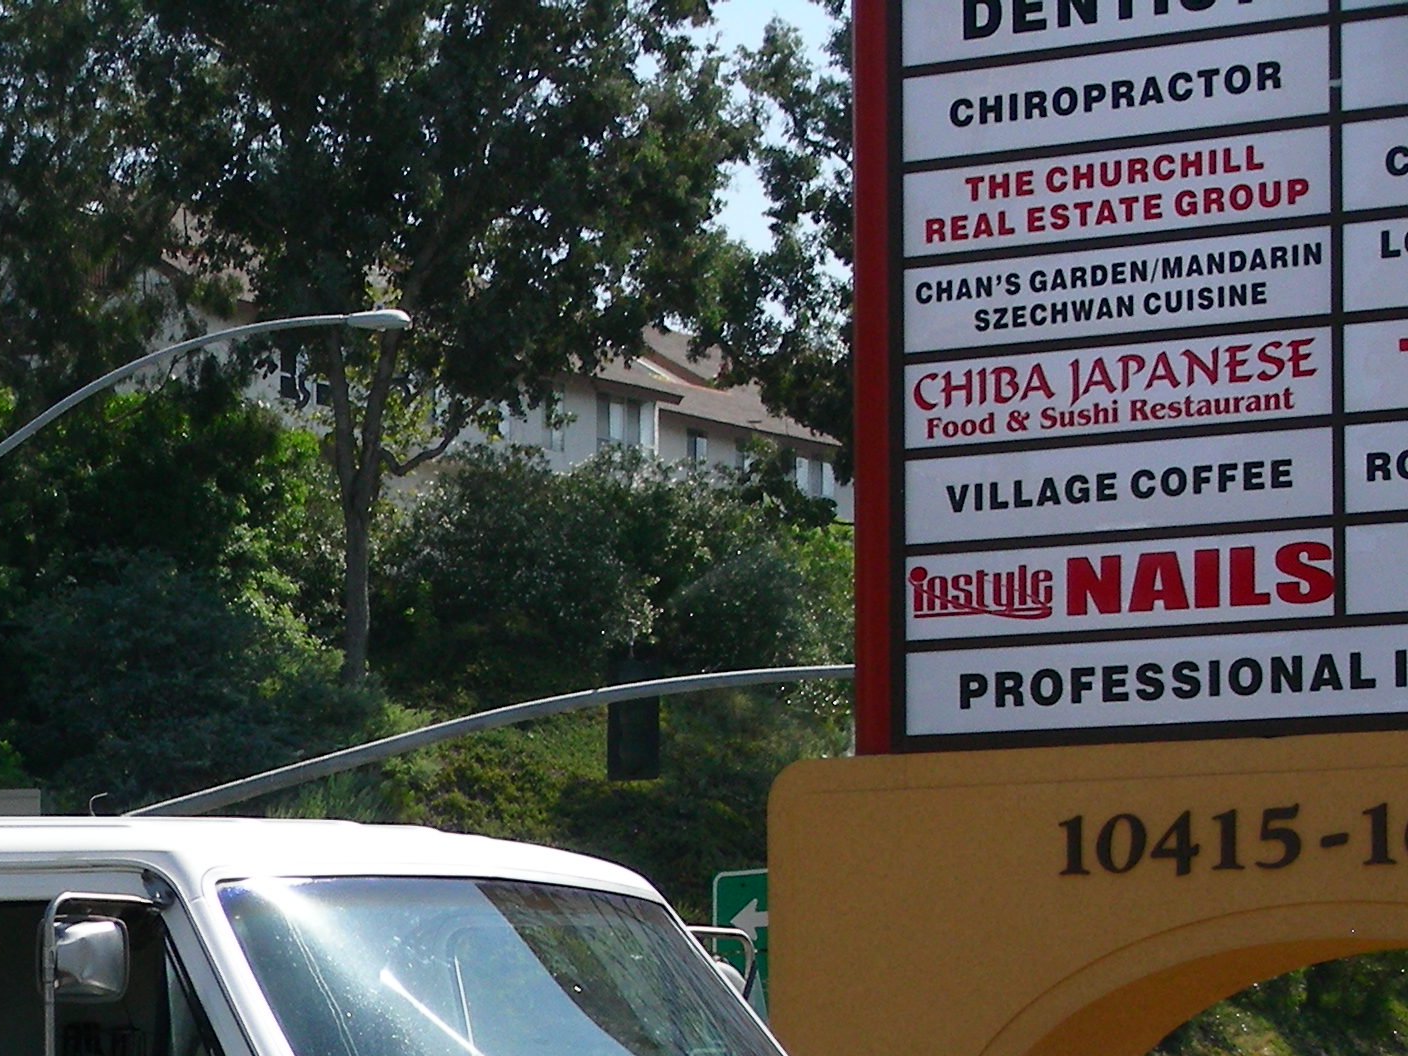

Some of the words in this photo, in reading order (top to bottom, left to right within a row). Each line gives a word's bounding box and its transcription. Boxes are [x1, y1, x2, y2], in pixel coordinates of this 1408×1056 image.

[949, 61, 1282, 128] CHIROPRACTOR
[965, 170, 1034, 202] THE
[1046, 145, 1264, 193] CHURCHILL
[925, 209, 1015, 244] REAL
[1027, 193, 1163, 233] ESTATE
[1174, 178, 1309, 217] GROUP
[915, 271, 1021, 304] CHAN'S
[1029, 242, 1323, 293] GARDEN/MANDARIN
[974, 294, 1134, 333] SZECHWAN
[1143, 282, 1268, 315] CUISINE
[913, 364, 1055, 411] CHIBA
[1068, 337, 1318, 405] JAPANESE
[926, 413, 995, 440] Food
[1006, 409, 1029, 432] &
[1040, 399, 1119, 430] Sushi
[1130, 387, 1295, 422] Restaurant
[946, 472, 1118, 513] VILLAGE
[1130, 458, 1293, 500] COFFEE
[907, 565, 1053, 619] instyle
[1066, 541, 1334, 617] NAILS
[959, 651, 1377, 710] PROFESSIONAL
